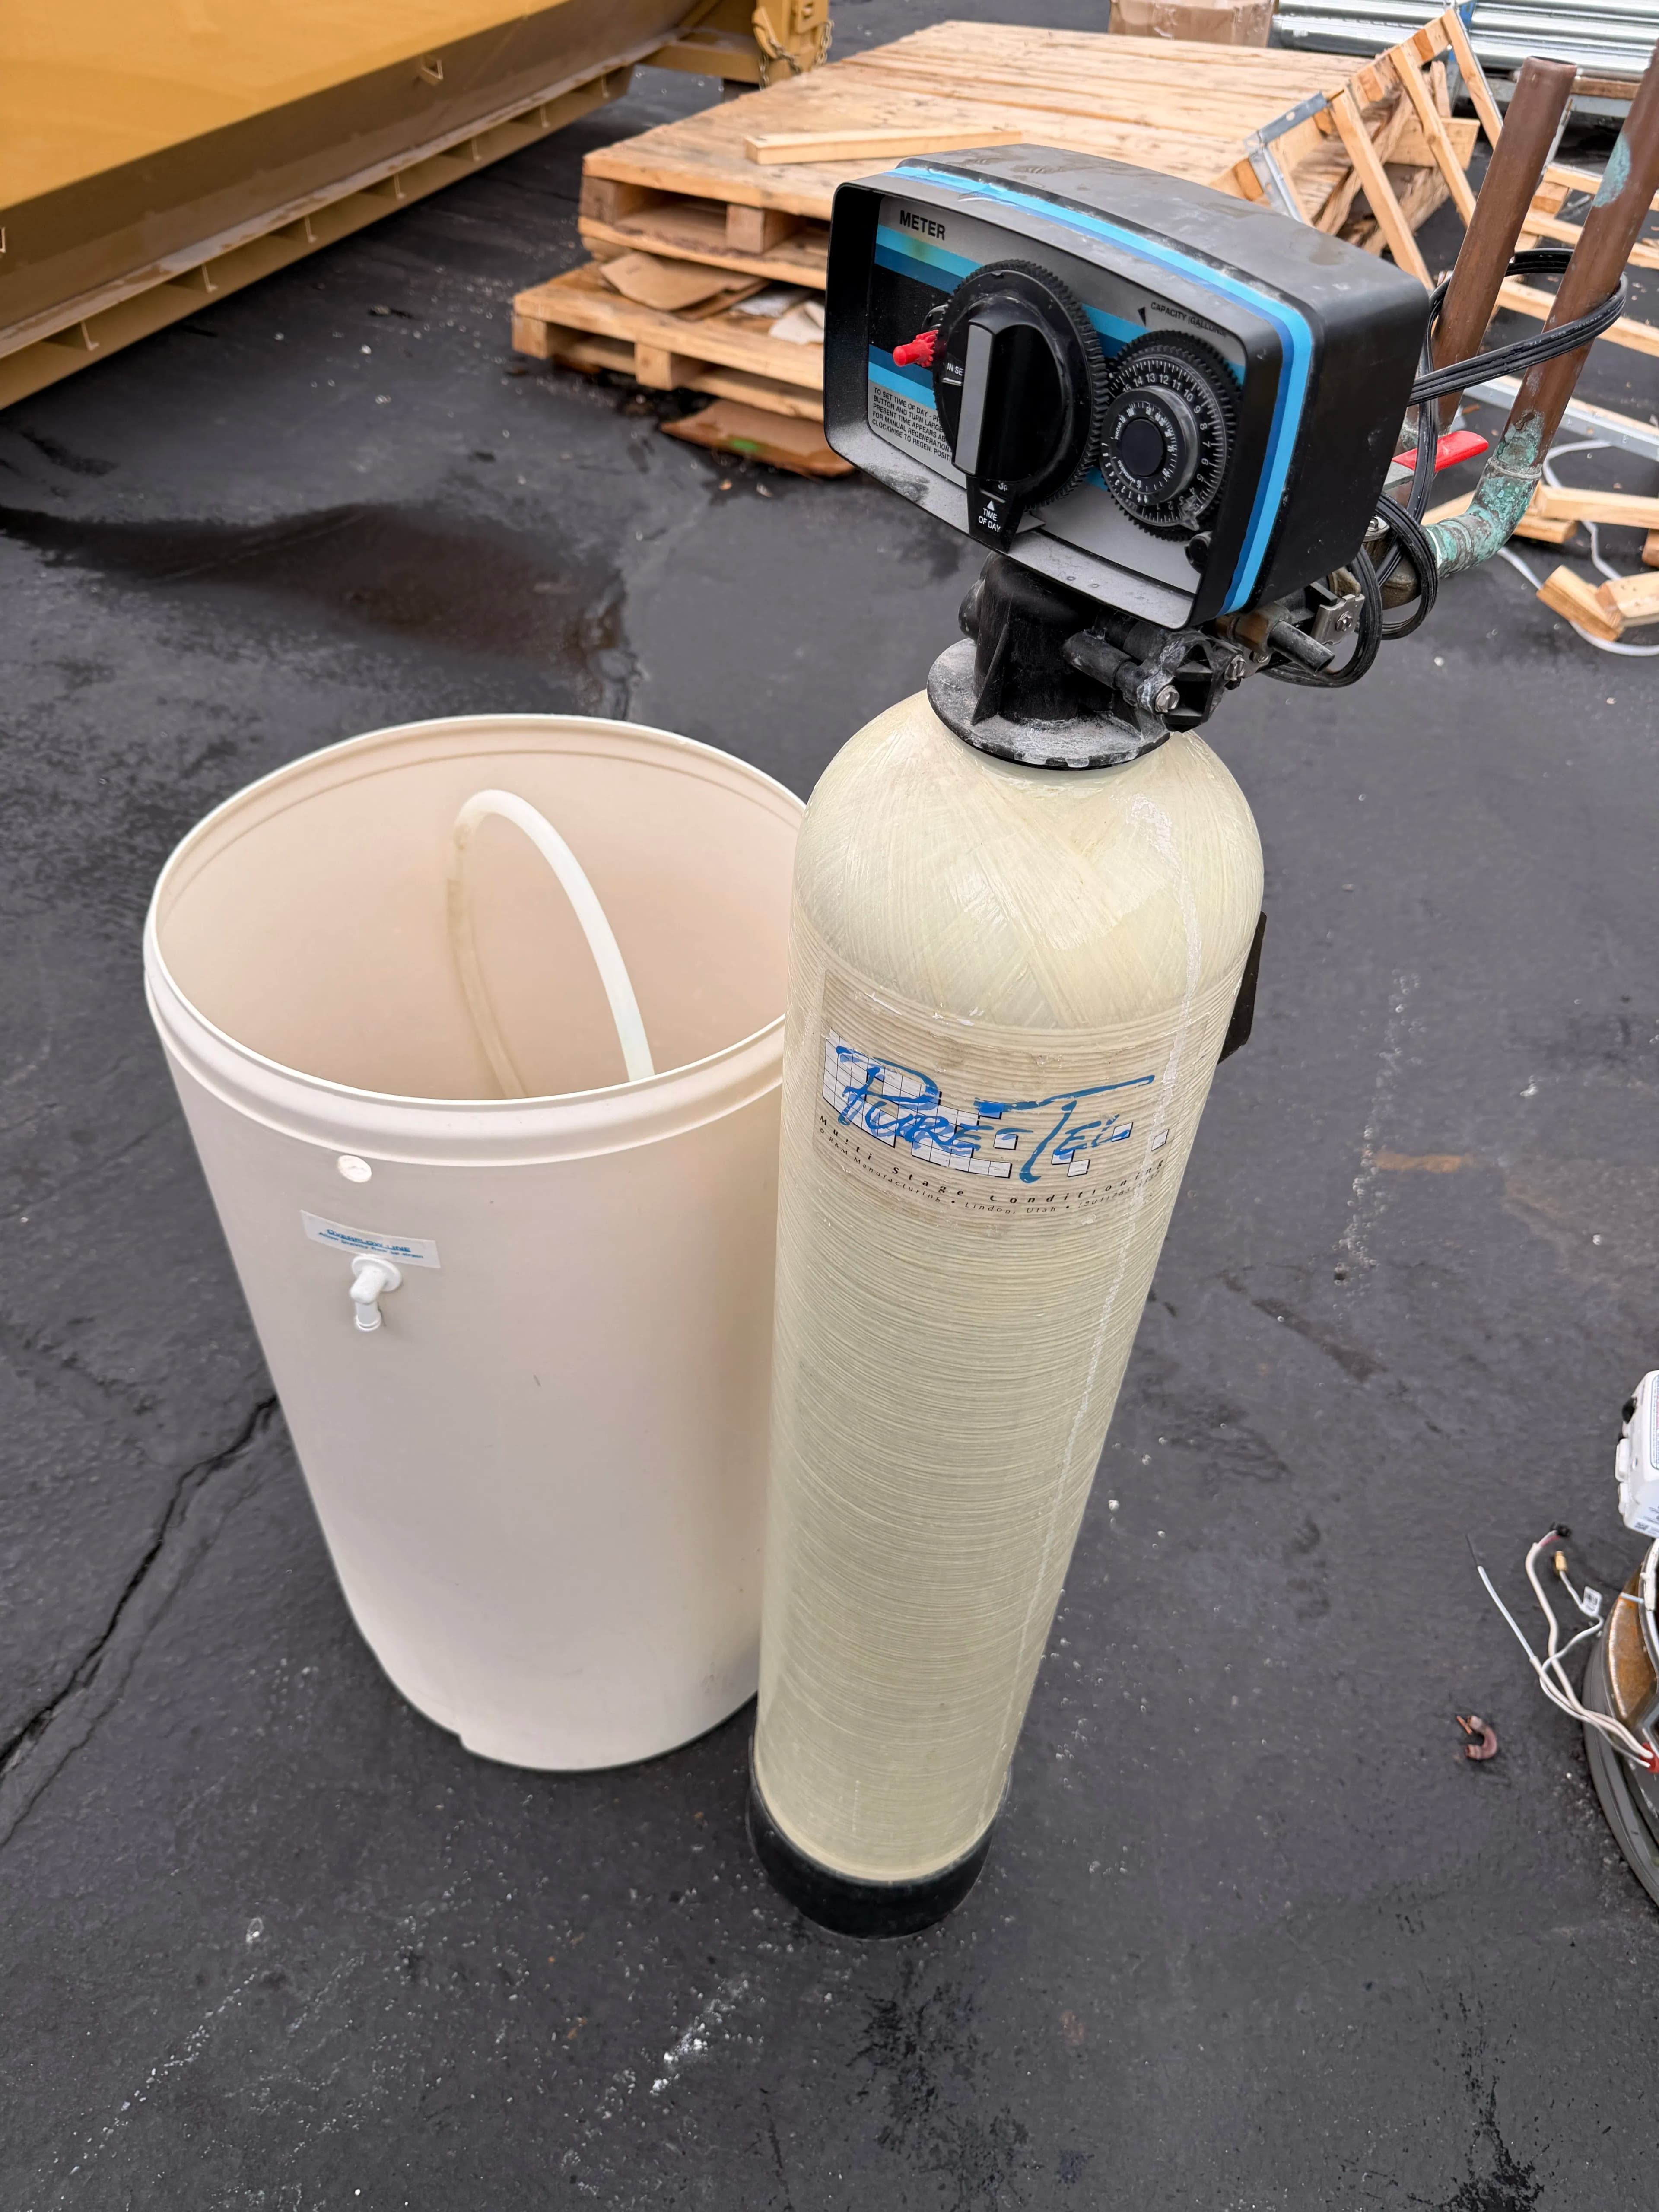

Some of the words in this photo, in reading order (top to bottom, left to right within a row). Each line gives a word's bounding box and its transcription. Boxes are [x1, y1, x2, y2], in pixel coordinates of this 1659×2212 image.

[899, 210, 945, 241] METER
[1151, 302, 1187, 321] CAPACITY
[947, 362, 954, 372] IN
[1133, 375, 1143, 387] 14
[1146, 373, 1156, 383] 13
[1159, 374, 1169, 385] 12
[1172, 379, 1182, 391] 11
[874, 387, 881, 395] TO
[883, 391, 893, 400] SET
[894, 396, 907, 407] TIME
[917, 407, 928, 417] DAY
[1184, 389, 1194, 402] 10
[874, 395, 894, 410] BUTTON
[896, 407, 907, 416] AND
[909, 411, 923, 423] TURN
[925, 419, 944, 432] LARGE
[1194, 405, 1201, 413] 9
[873, 403, 896, 418] PRESENT
[898, 414, 911, 426] TIME
[912, 422, 937, 438] APPEARS
[872, 419, 903, 439] CLOCKWISE
[904, 434, 911, 442] TO
[912, 438, 932, 452] REGEN.
[873, 410, 883, 421] FOR
[885, 416, 906, 432] MANUAL
[908, 427, 949, 452] REGENERATION
[1196, 473, 1204, 482] 5
[983, 508, 998, 521] TIME
[978, 515, 987, 524] OF
[988, 521, 1001, 533] DAY
[853, 1157, 941, 1203] Manufacturing
[892, 1167, 964, 1196] Stage
[327, 1229, 383, 1247] OVERFLOW
